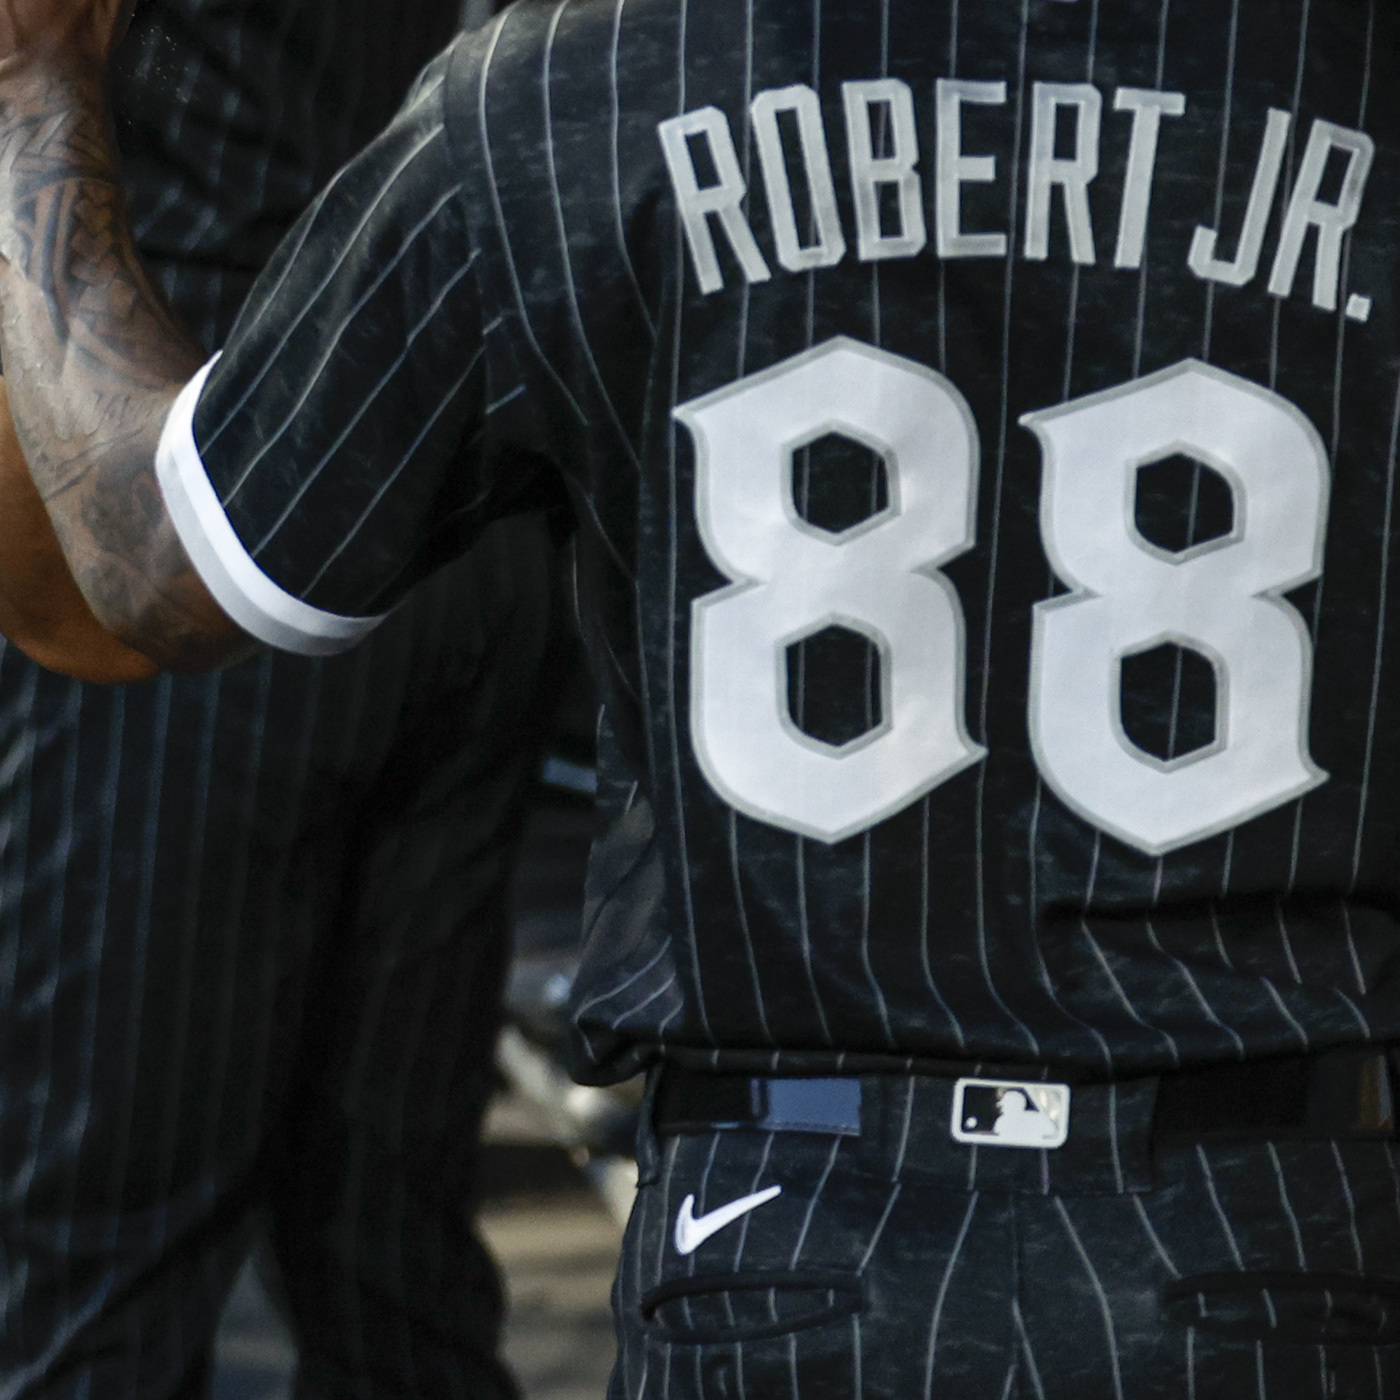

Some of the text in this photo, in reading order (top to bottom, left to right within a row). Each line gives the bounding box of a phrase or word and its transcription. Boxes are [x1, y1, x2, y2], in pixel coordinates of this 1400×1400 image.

[656, 75, 1376, 323] ROBERT JR.
[671, 334, 1332, 858] 88
